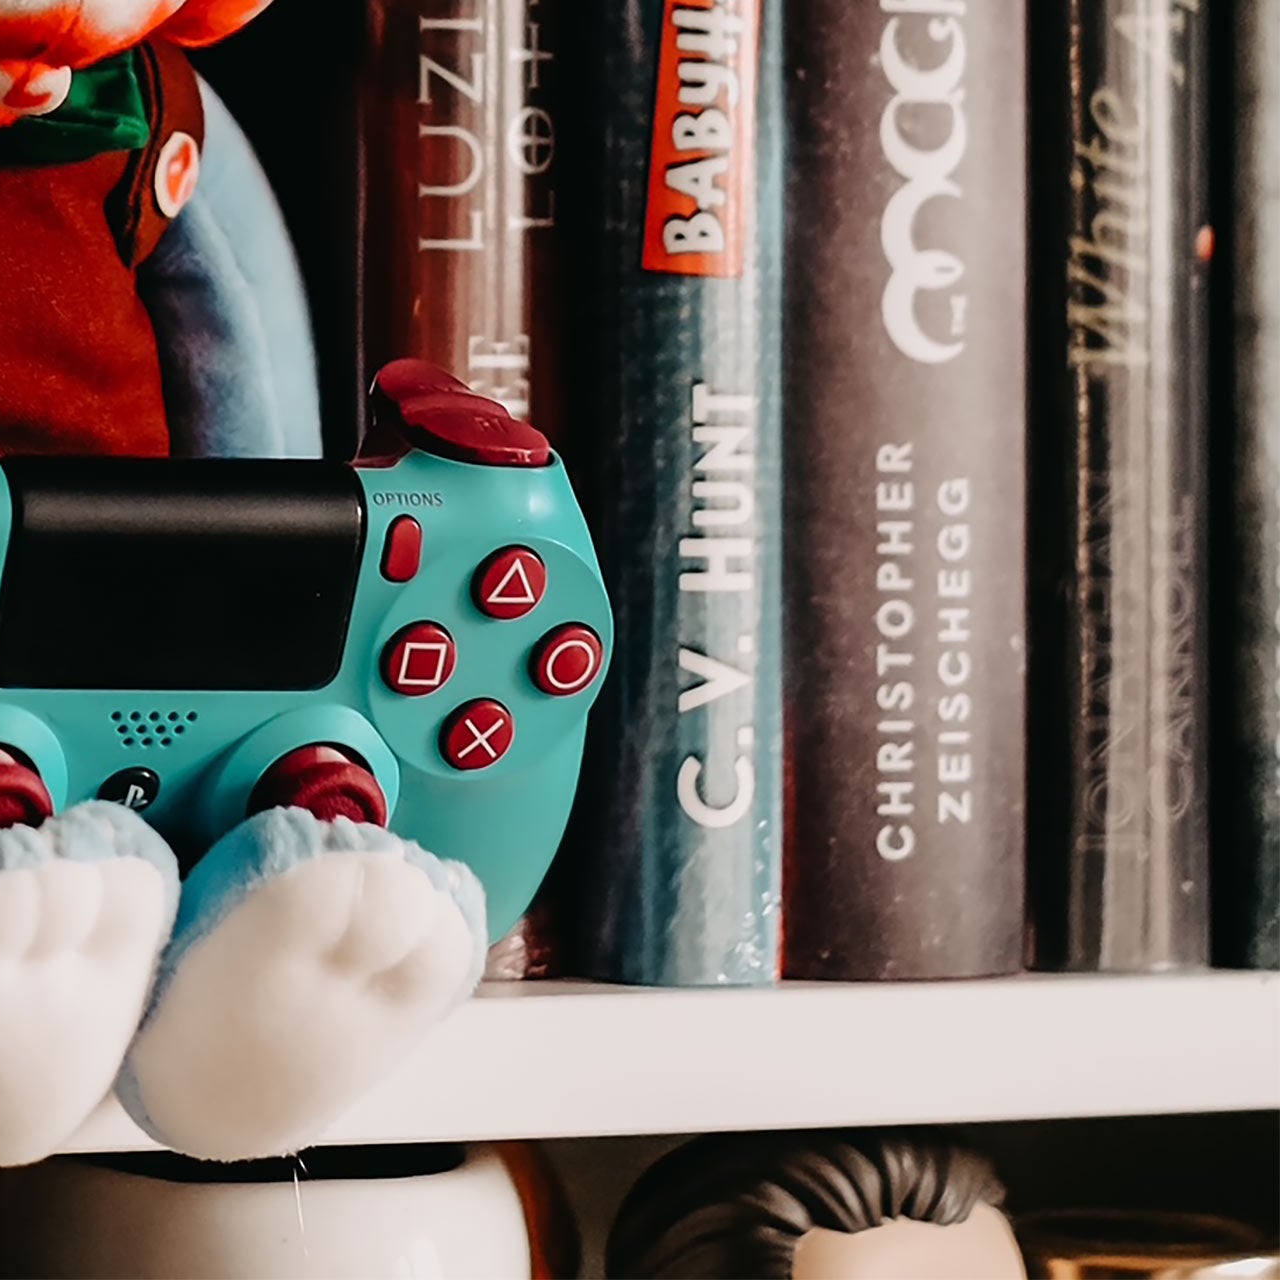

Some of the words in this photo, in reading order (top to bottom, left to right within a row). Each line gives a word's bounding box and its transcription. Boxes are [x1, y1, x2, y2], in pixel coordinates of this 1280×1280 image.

[1067, 87, 1150, 368] White
[372, 490, 444, 509] OPTIONS
[678, 383, 759, 593] HUNT
[875, 440, 916, 862] CHRISTOPHER
[936, 476, 973, 824] ZEISCHEGG
